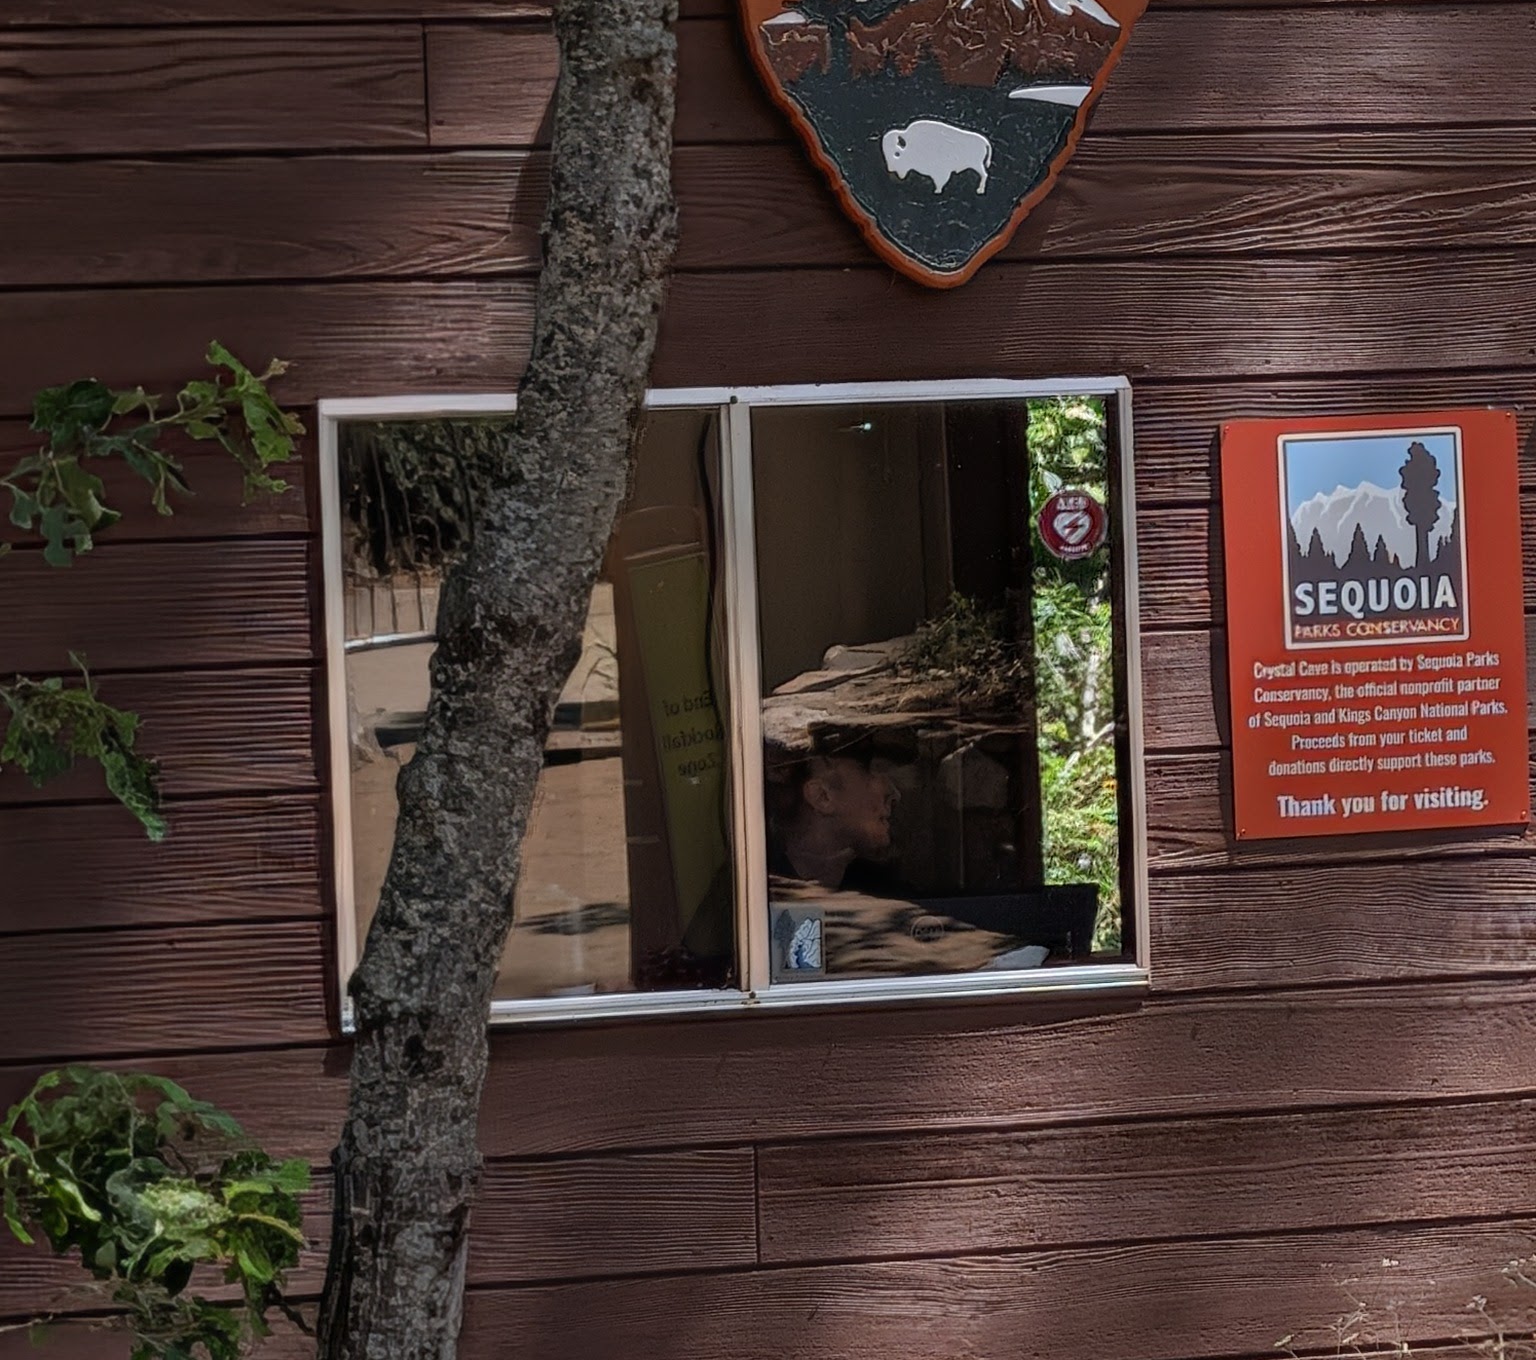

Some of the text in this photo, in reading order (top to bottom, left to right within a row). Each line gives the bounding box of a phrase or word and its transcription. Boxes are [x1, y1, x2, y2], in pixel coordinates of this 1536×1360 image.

[1295, 575, 1457, 619] SEQUOIA
[1294, 617, 1460, 638] PARKS CONSERVANCY
[1253, 651, 1500, 679] Crystal Cave is operated by Sequoia Parks
[1254, 677, 1501, 703] Conservancy, the official nonprofit partner
[1248, 699, 1508, 729] of Sequoia and Kings Canyon National Parks.
[1291, 725, 1468, 750] Proceeds from your ticket and
[1268, 749, 1496, 776] donations directly support these parks.
[1277, 786, 1489, 818] Thank you for visiting.
